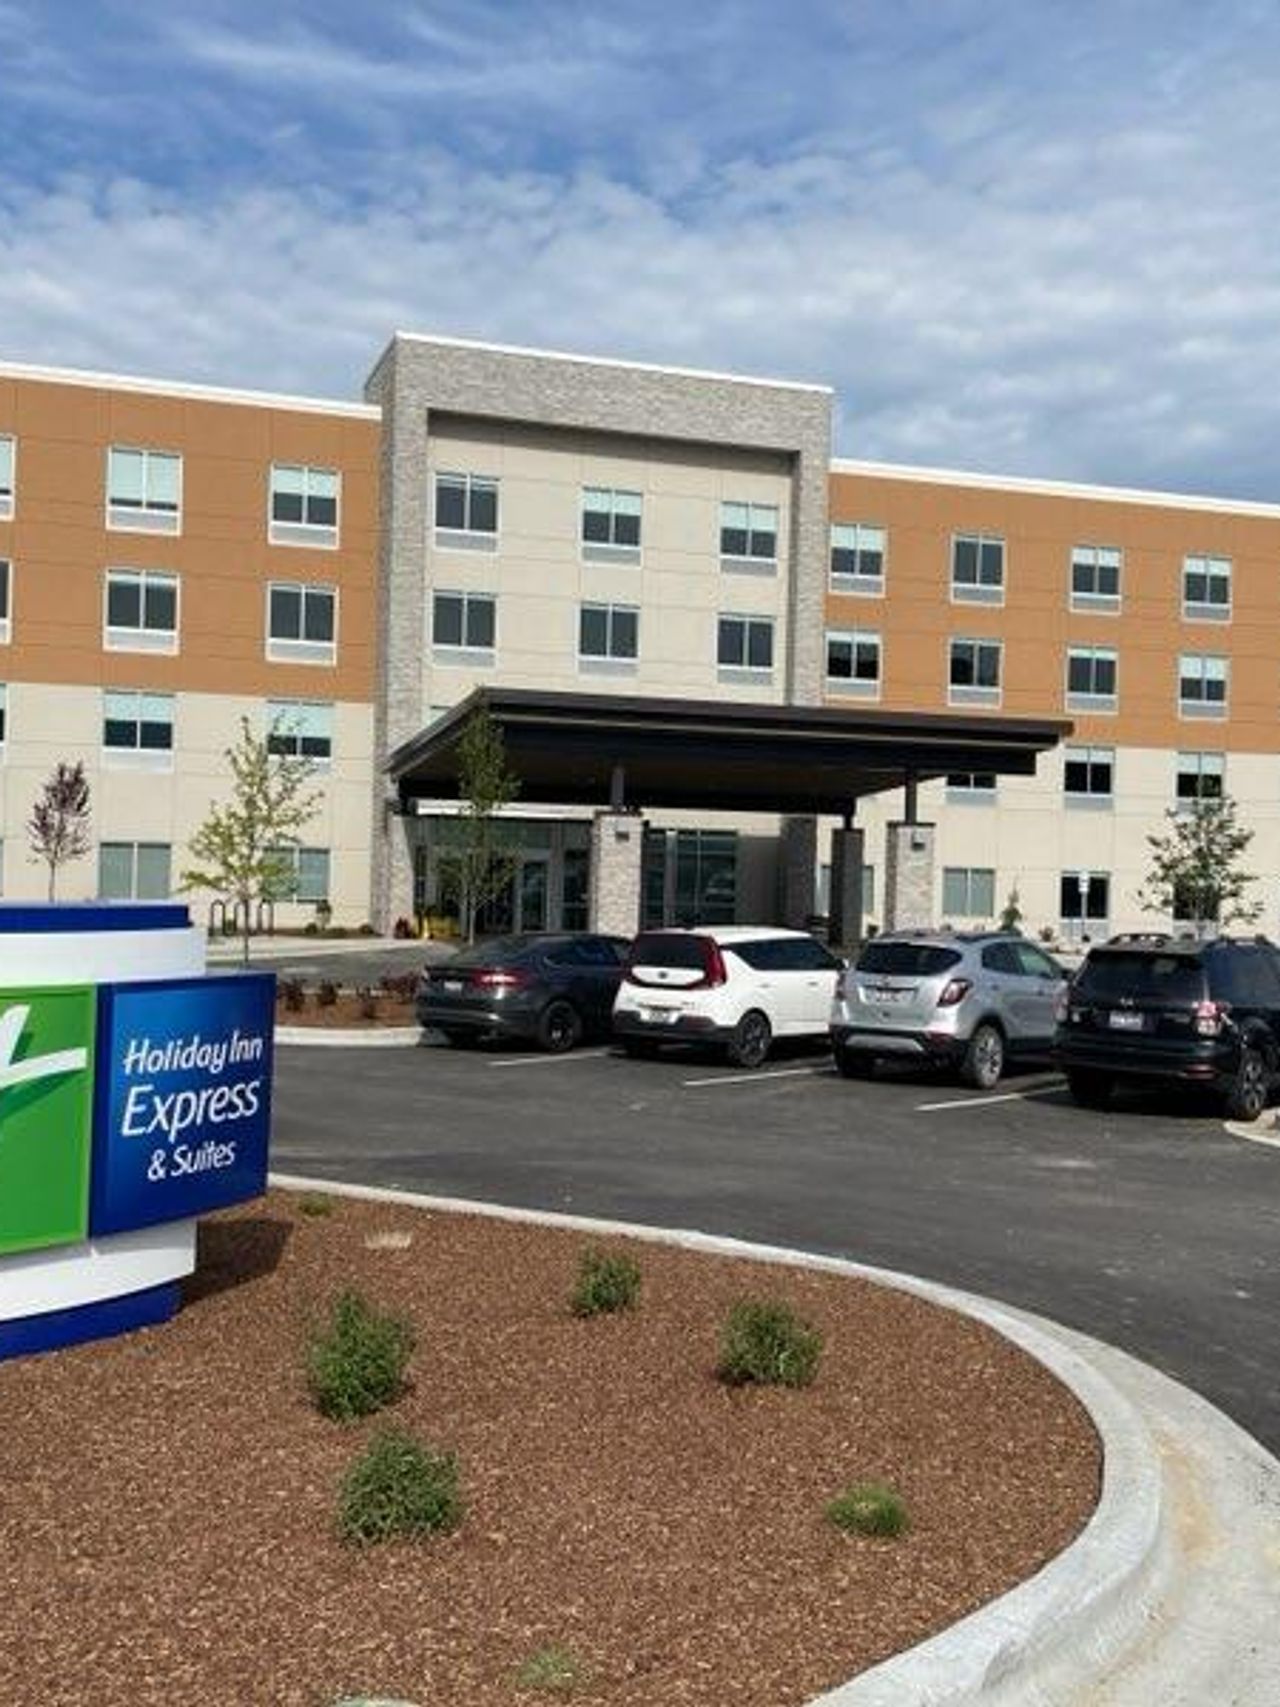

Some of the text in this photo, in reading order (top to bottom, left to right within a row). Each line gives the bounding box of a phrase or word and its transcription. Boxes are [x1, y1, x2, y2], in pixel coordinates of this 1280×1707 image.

[123, 1034, 228, 1075] Holiday
[228, 1029, 263, 1063] Inn
[121, 1080, 261, 1143] Express
[147, 1141, 236, 1181] & Suites
